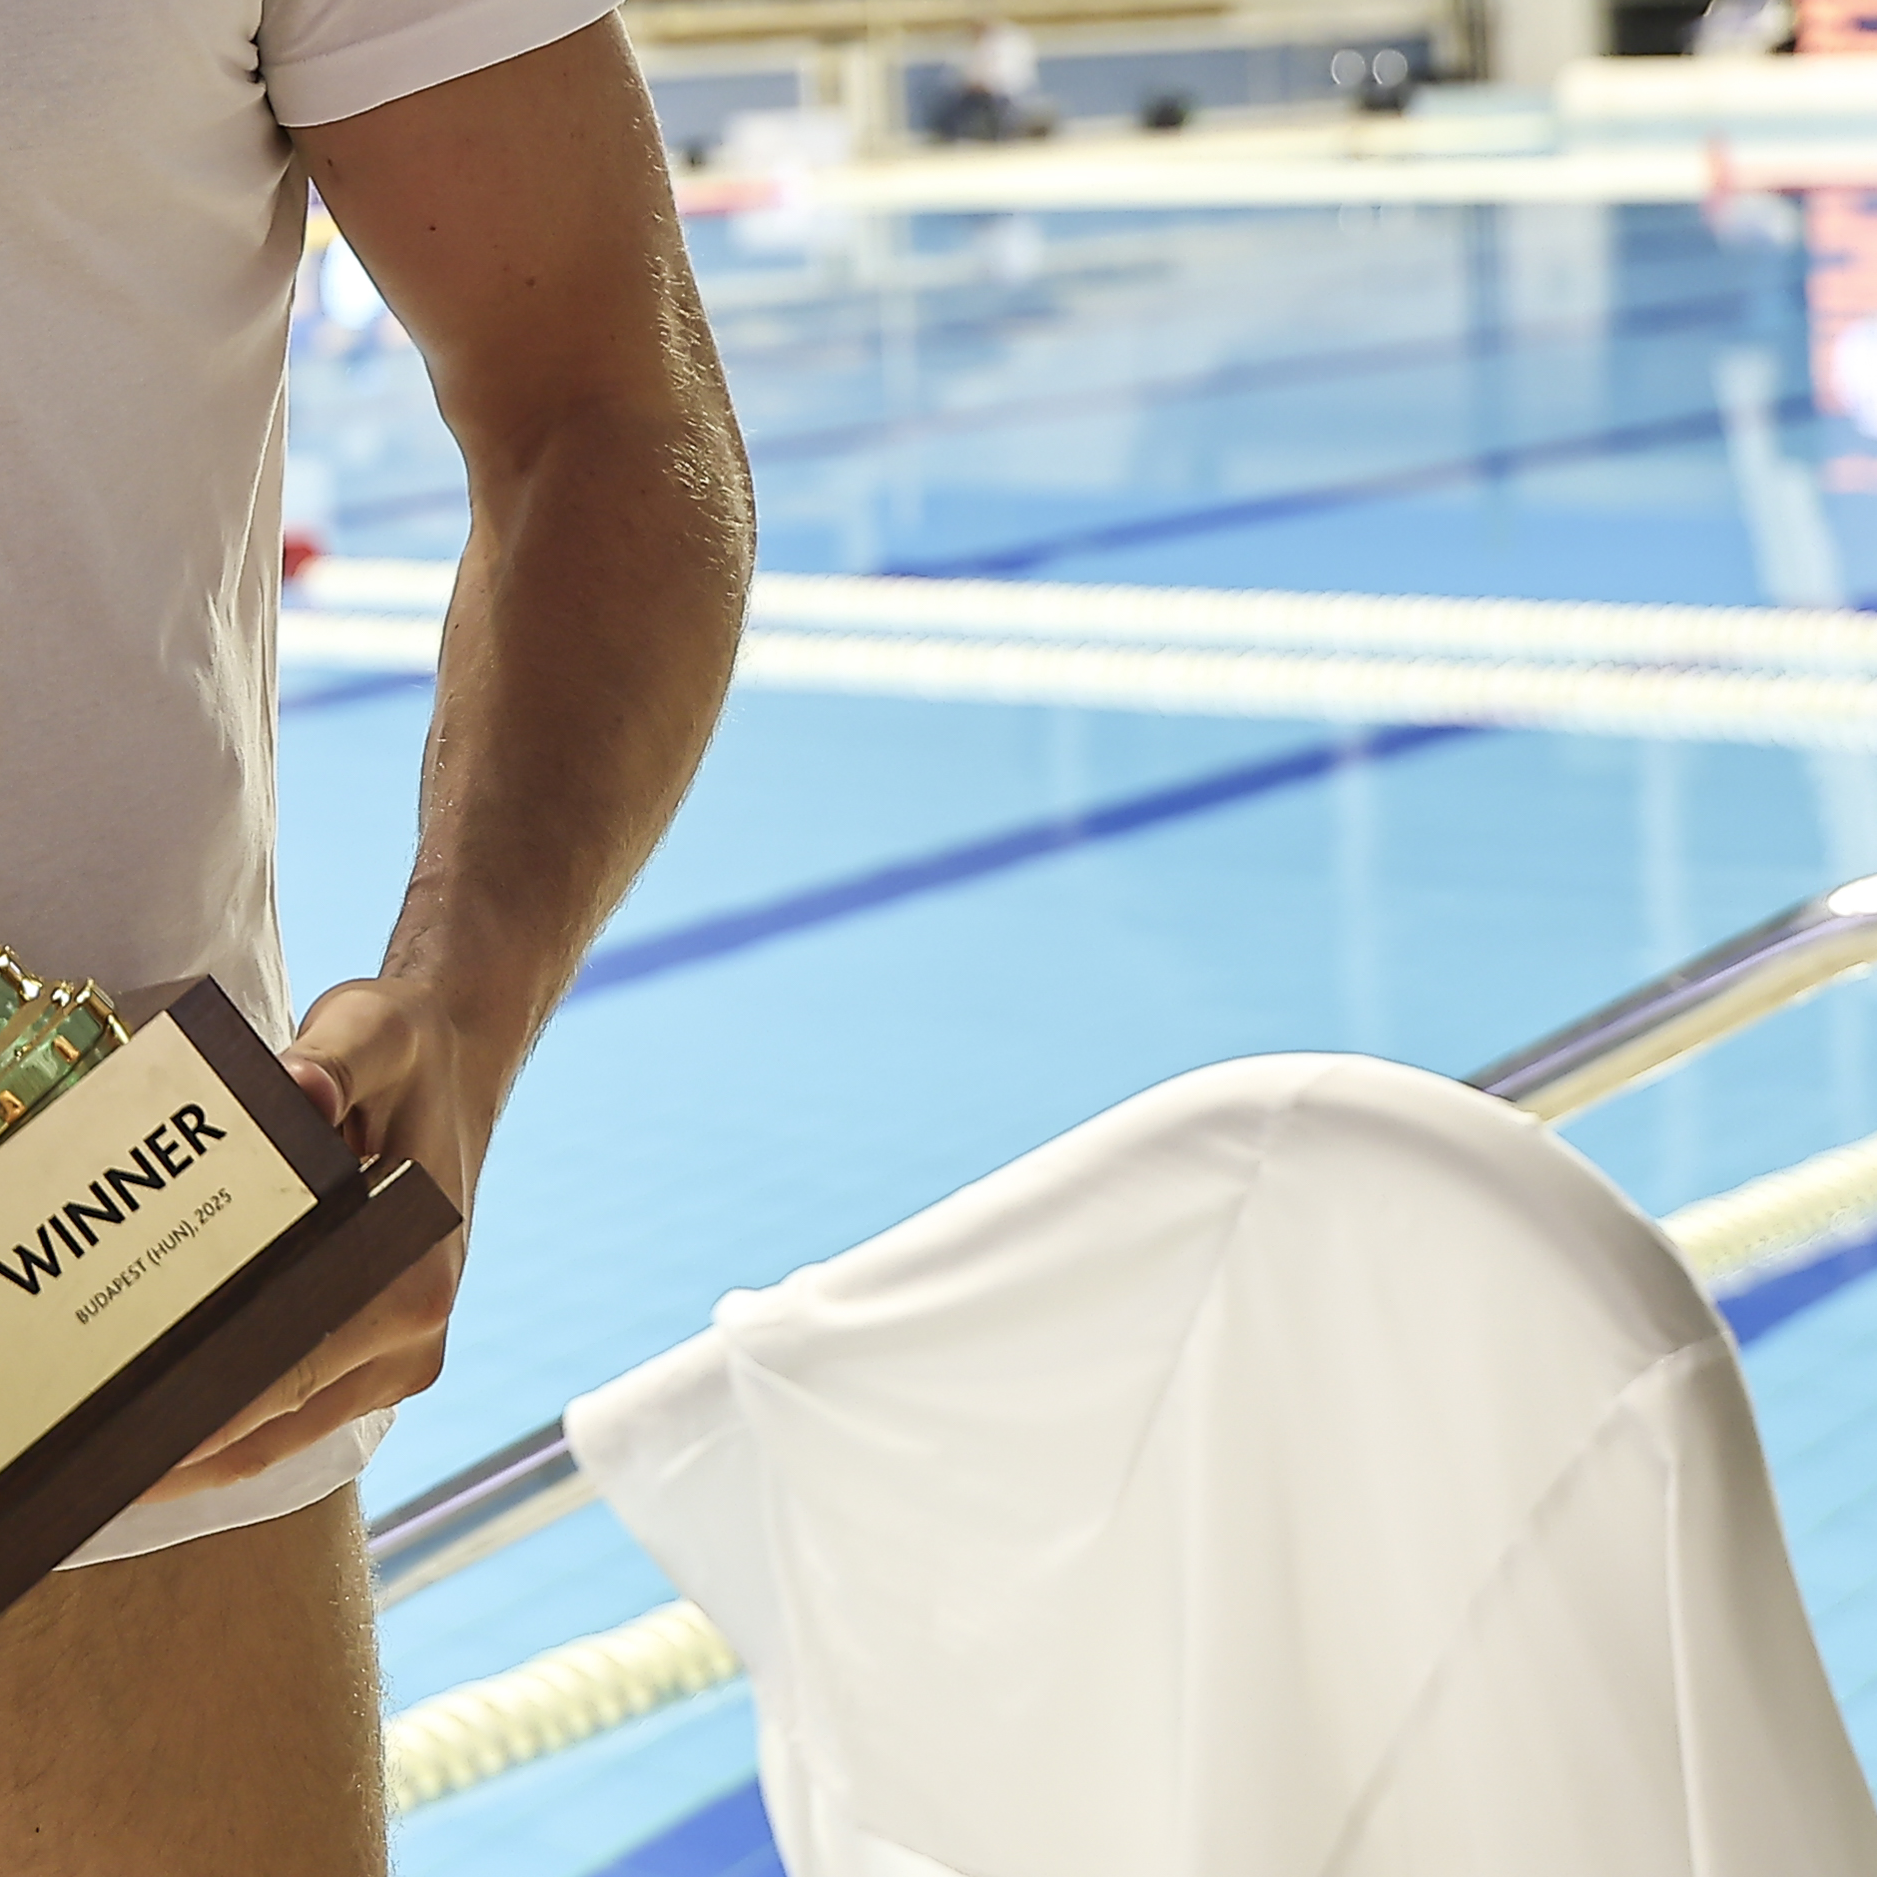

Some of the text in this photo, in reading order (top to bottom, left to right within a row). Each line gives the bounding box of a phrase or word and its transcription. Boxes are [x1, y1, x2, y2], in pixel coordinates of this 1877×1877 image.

[74, 1187, 233, 1325] BUDAPEST (HUN), 2025
